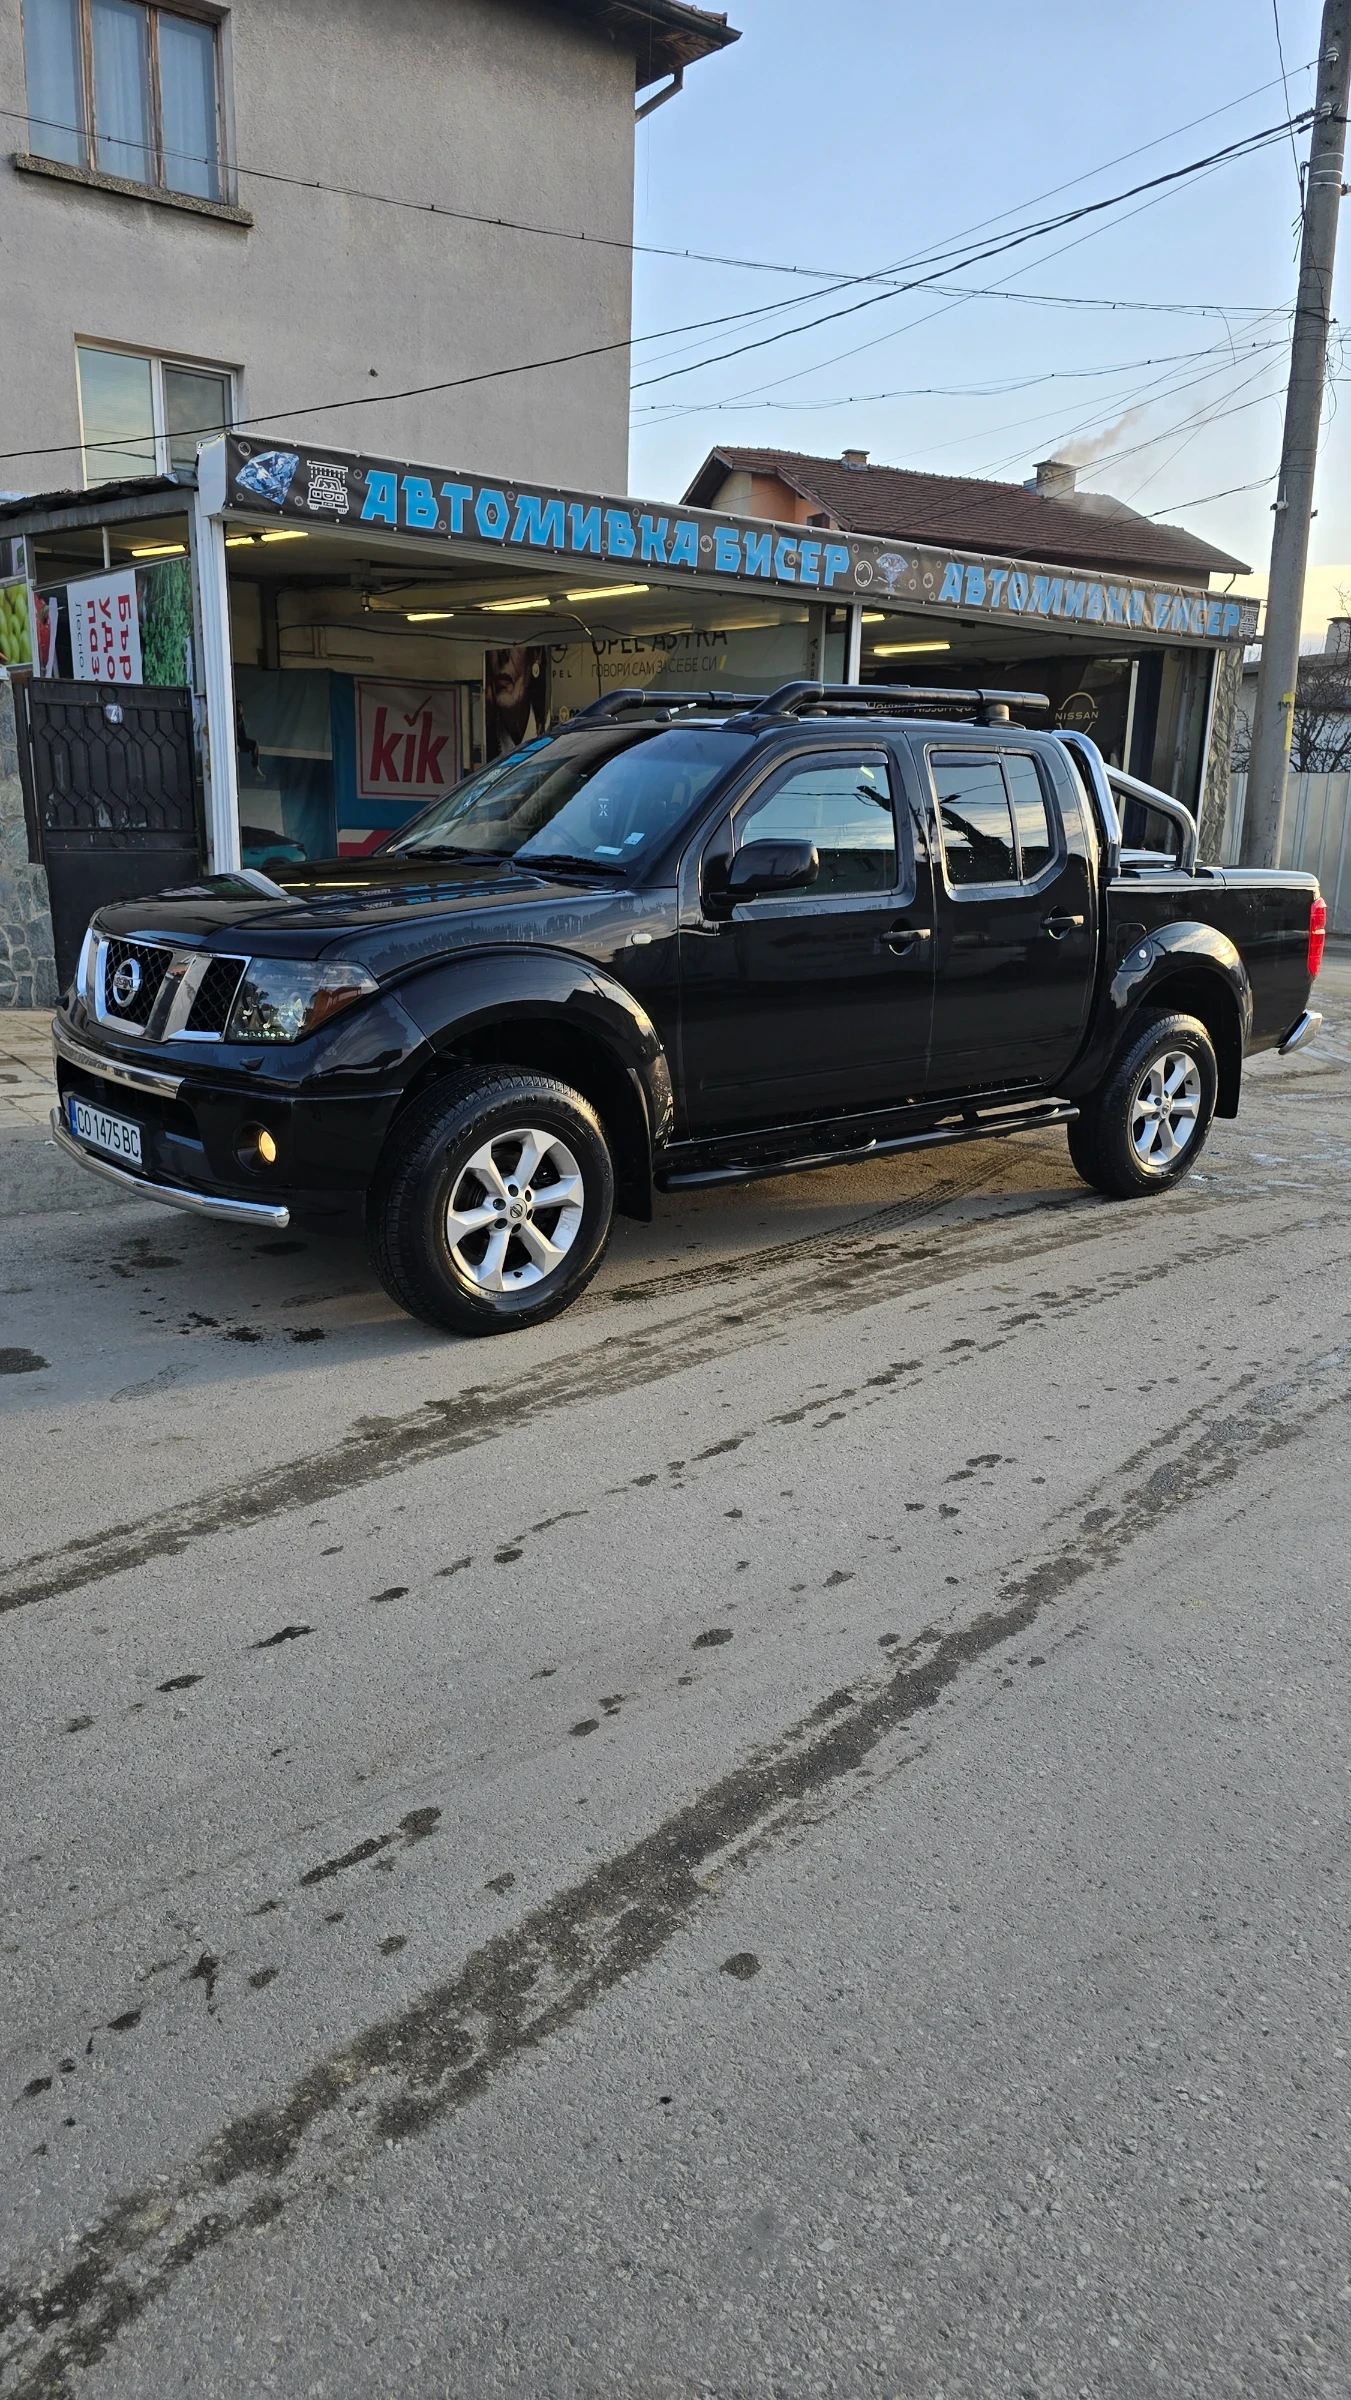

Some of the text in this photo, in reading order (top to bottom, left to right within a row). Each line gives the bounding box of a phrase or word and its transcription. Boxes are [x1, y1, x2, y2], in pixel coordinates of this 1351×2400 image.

[360, 469, 850, 586] АВТОМИВКА БИСЕР
[938, 562, 1240, 638] АВТОМИВКА БИСЕР
[592, 637, 645, 655] OPEL
[552, 669, 572, 678] PEL
[591, 662, 631, 678] ГОВОРИ
[632, 661, 655, 676] САМ
[668, 657, 698, 673] СЕБЕ
[701, 655, 717, 672] СИ
[1054, 711, 1099, 720] NISSAN
[369, 696, 450, 784] kik
